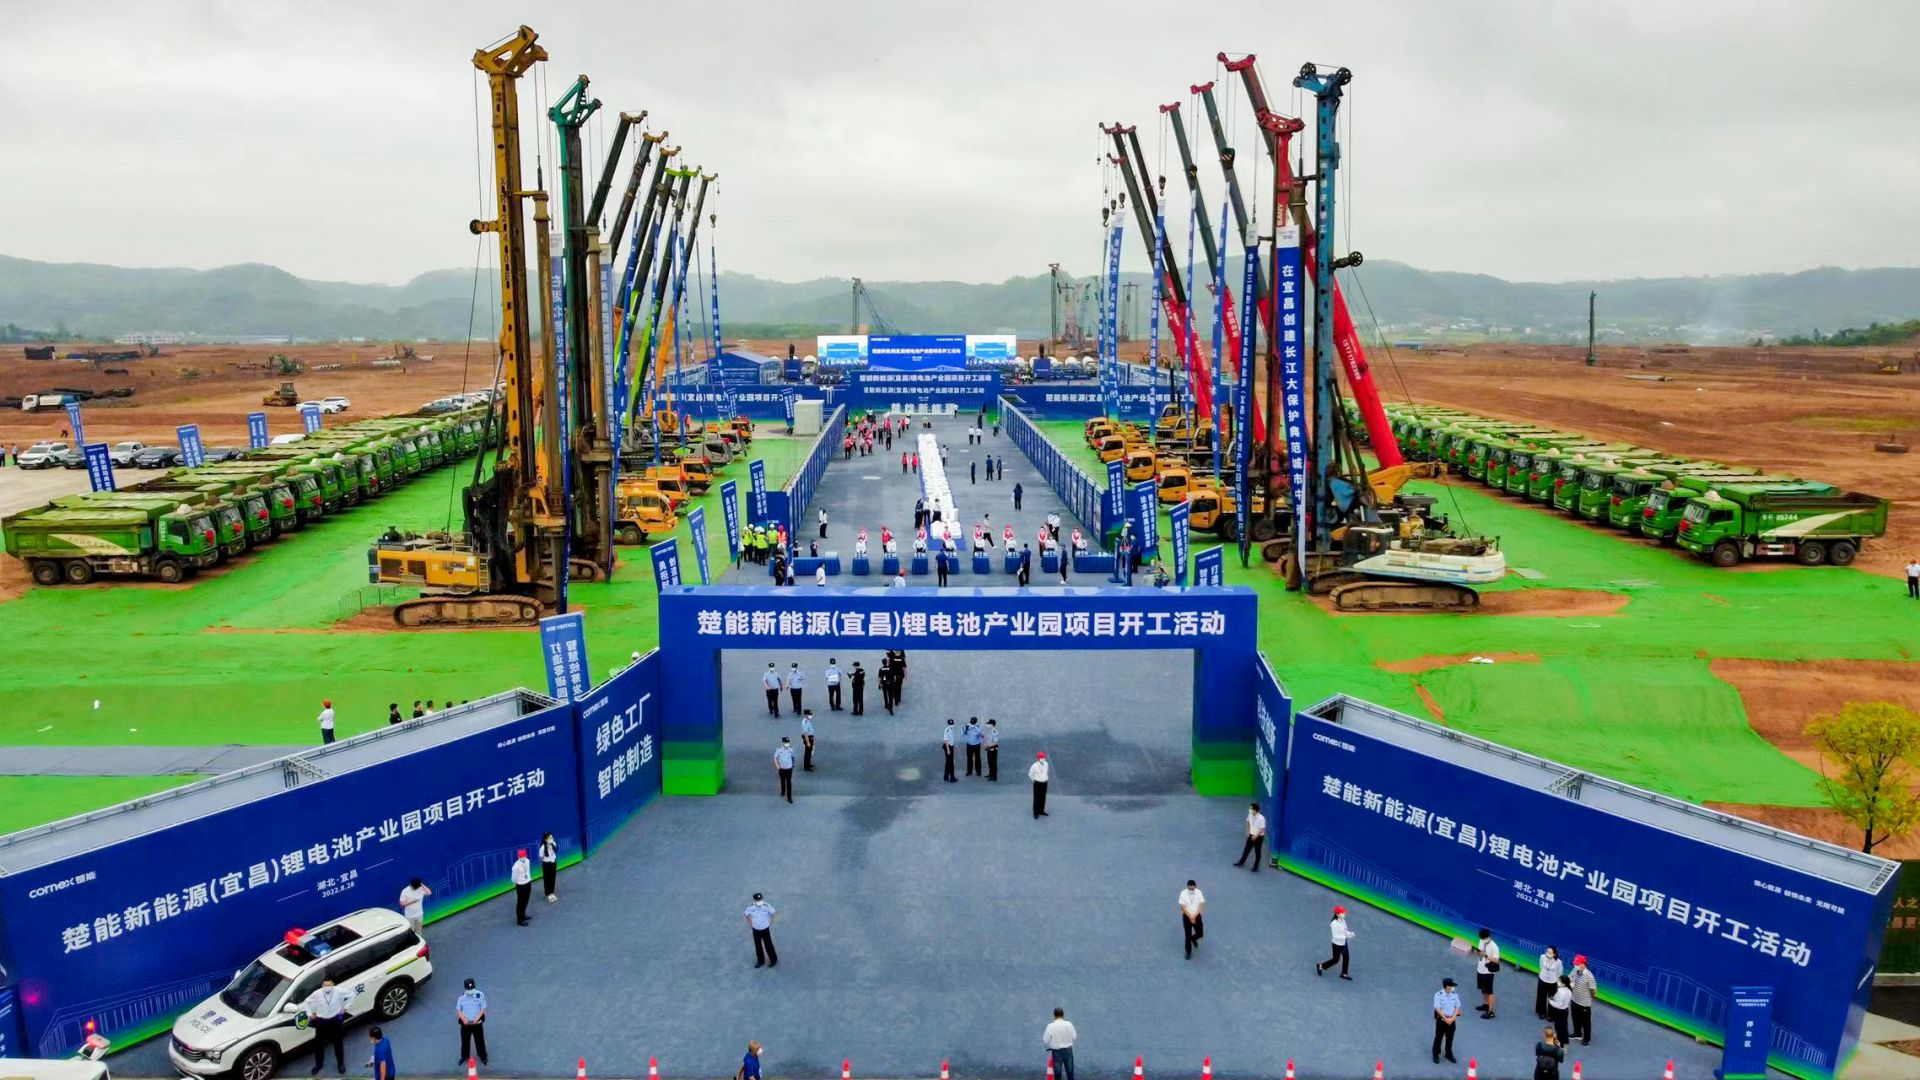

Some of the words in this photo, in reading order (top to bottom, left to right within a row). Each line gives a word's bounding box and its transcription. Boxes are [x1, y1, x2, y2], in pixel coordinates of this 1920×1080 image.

[697, 609, 1226, 637] 楚能新能源(宜昌)锂电池产业园项目开工活动
[597, 692, 651, 756] 绿色工厂
[597, 733, 653, 800] 智能制造
[63, 767, 546, 954] 楚能新能源(宜昌)锂电池产业园项目开工活动
[1322, 774, 1812, 967] 楚能新能源(宜昌)锂电池产业园项目开工活动
[355, 981, 366, 996] 安
